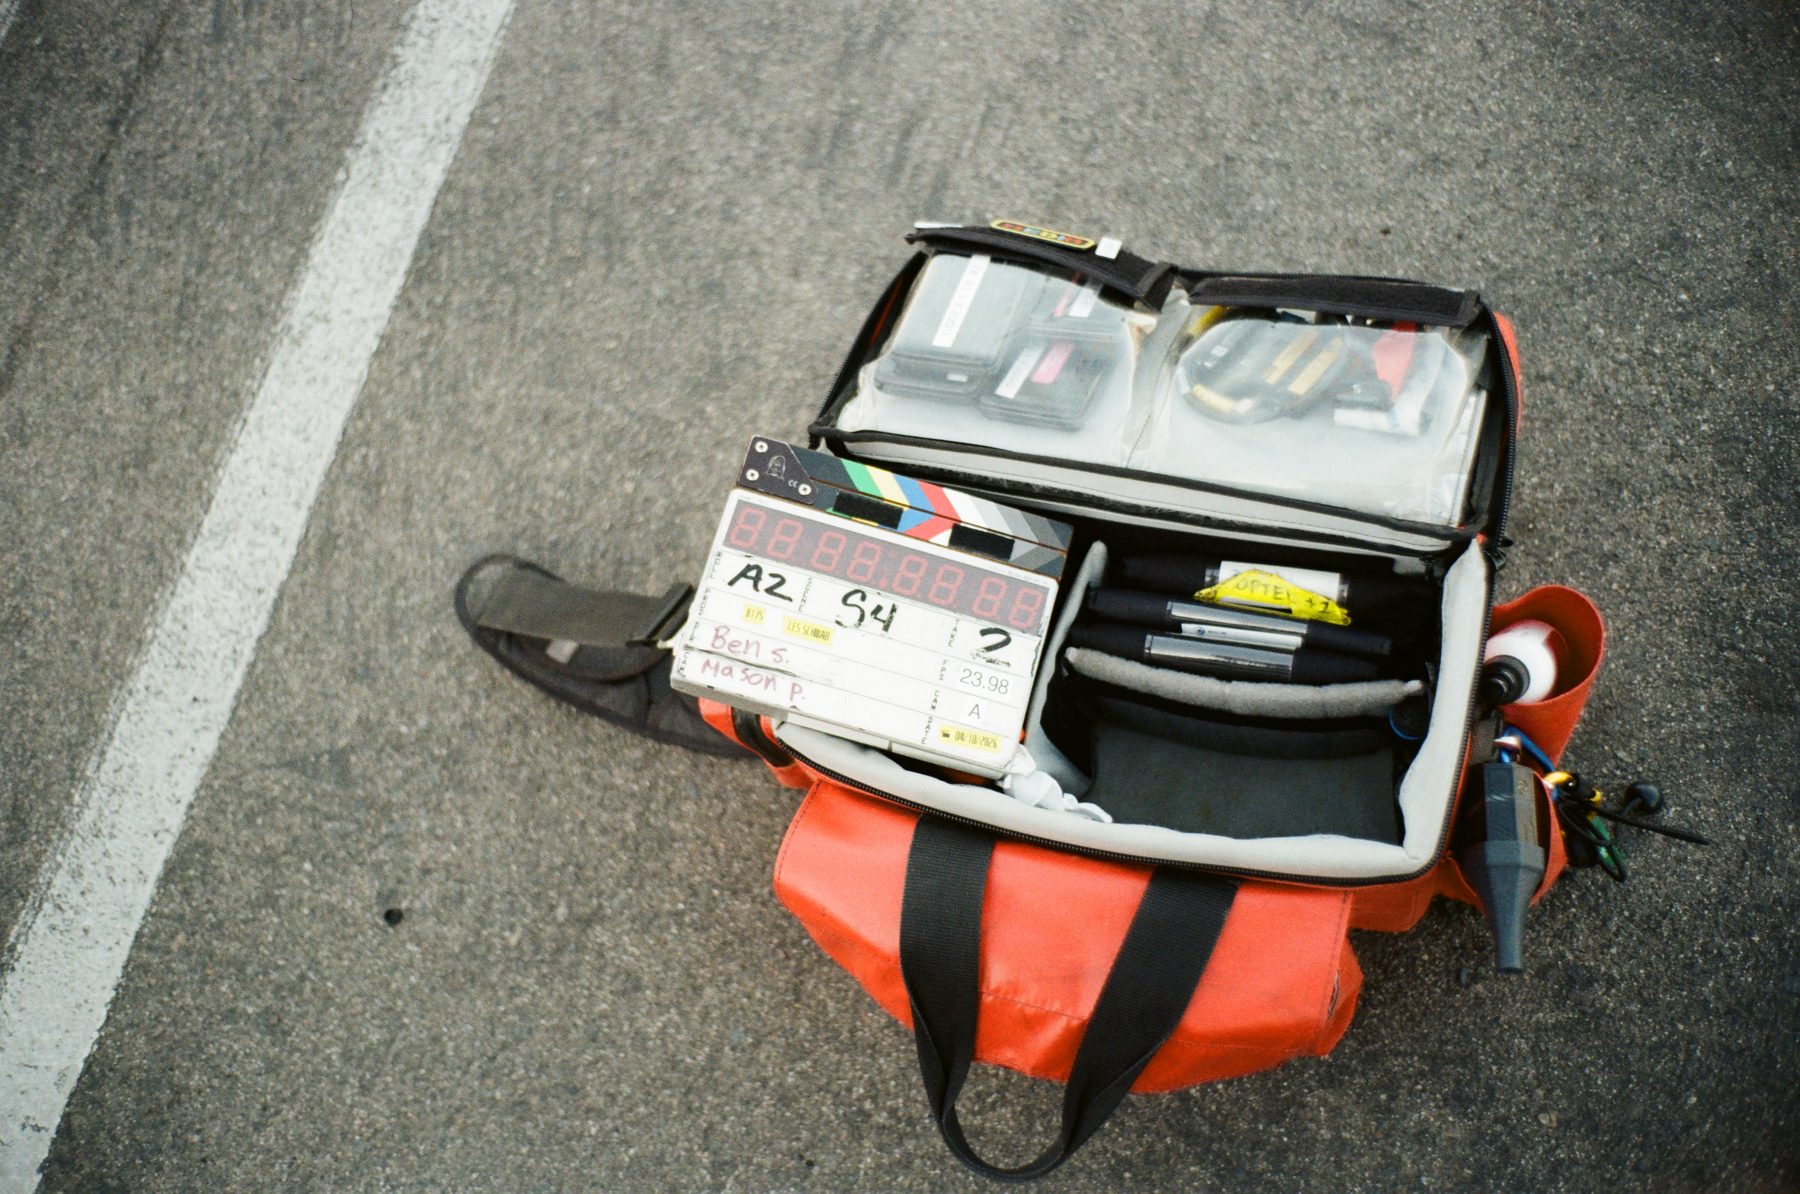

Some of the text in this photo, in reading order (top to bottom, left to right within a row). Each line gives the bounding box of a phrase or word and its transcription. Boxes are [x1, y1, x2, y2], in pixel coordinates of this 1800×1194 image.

[728, 564, 793, 602] A2
[834, 589, 897, 632] S4
[710, 625, 760, 658] Ben
[948, 619, 960, 647] TAKE
[971, 627, 1012, 667] 2
[701, 659, 776, 691] Mason
[960, 668, 1010, 695] 23.98
[968, 703, 981, 720] A
